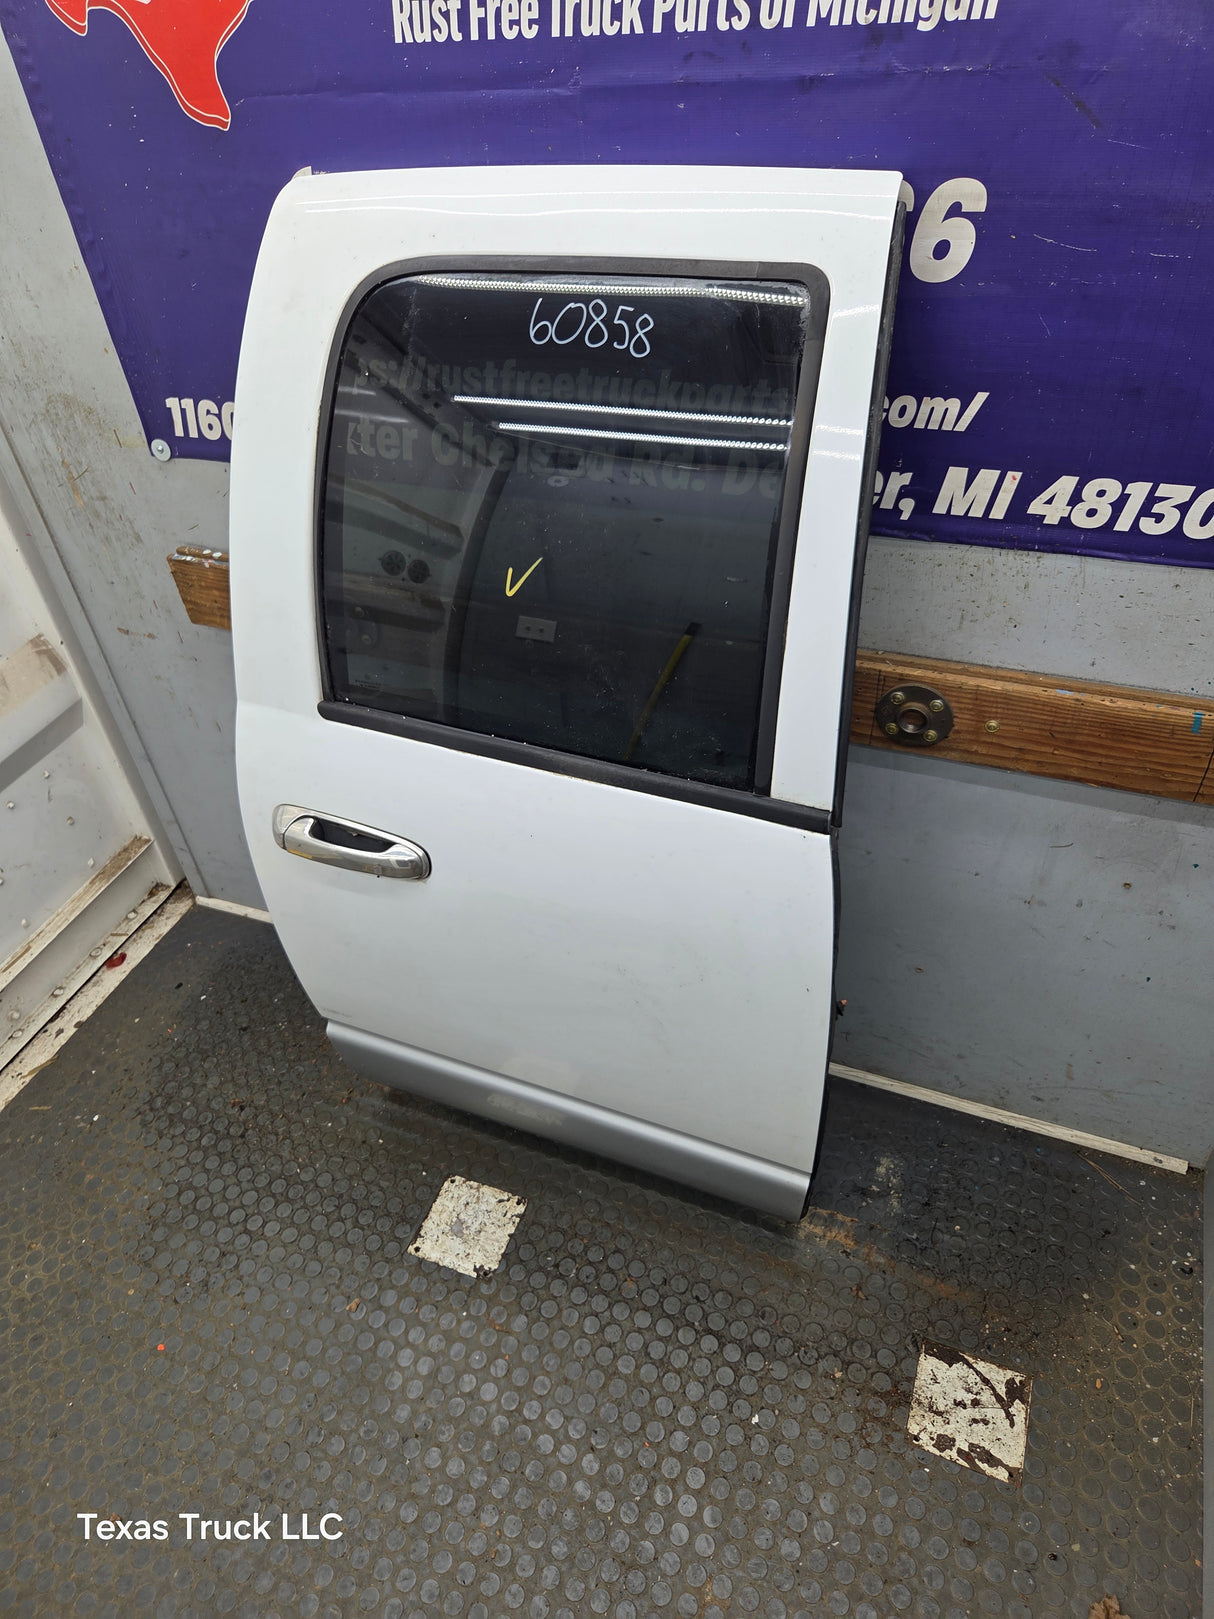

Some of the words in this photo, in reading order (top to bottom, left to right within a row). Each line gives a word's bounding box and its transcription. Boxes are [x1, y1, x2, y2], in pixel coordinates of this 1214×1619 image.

[392, 0, 463, 44] Rust
[469, 0, 540, 41] Free
[551, 0, 645, 38] Truck
[652, 0, 751, 34] Parts
[529, 298, 655, 358] 60858
[931, 466, 1023, 520] MI
[1026, 475, 1214, 540] 48130
